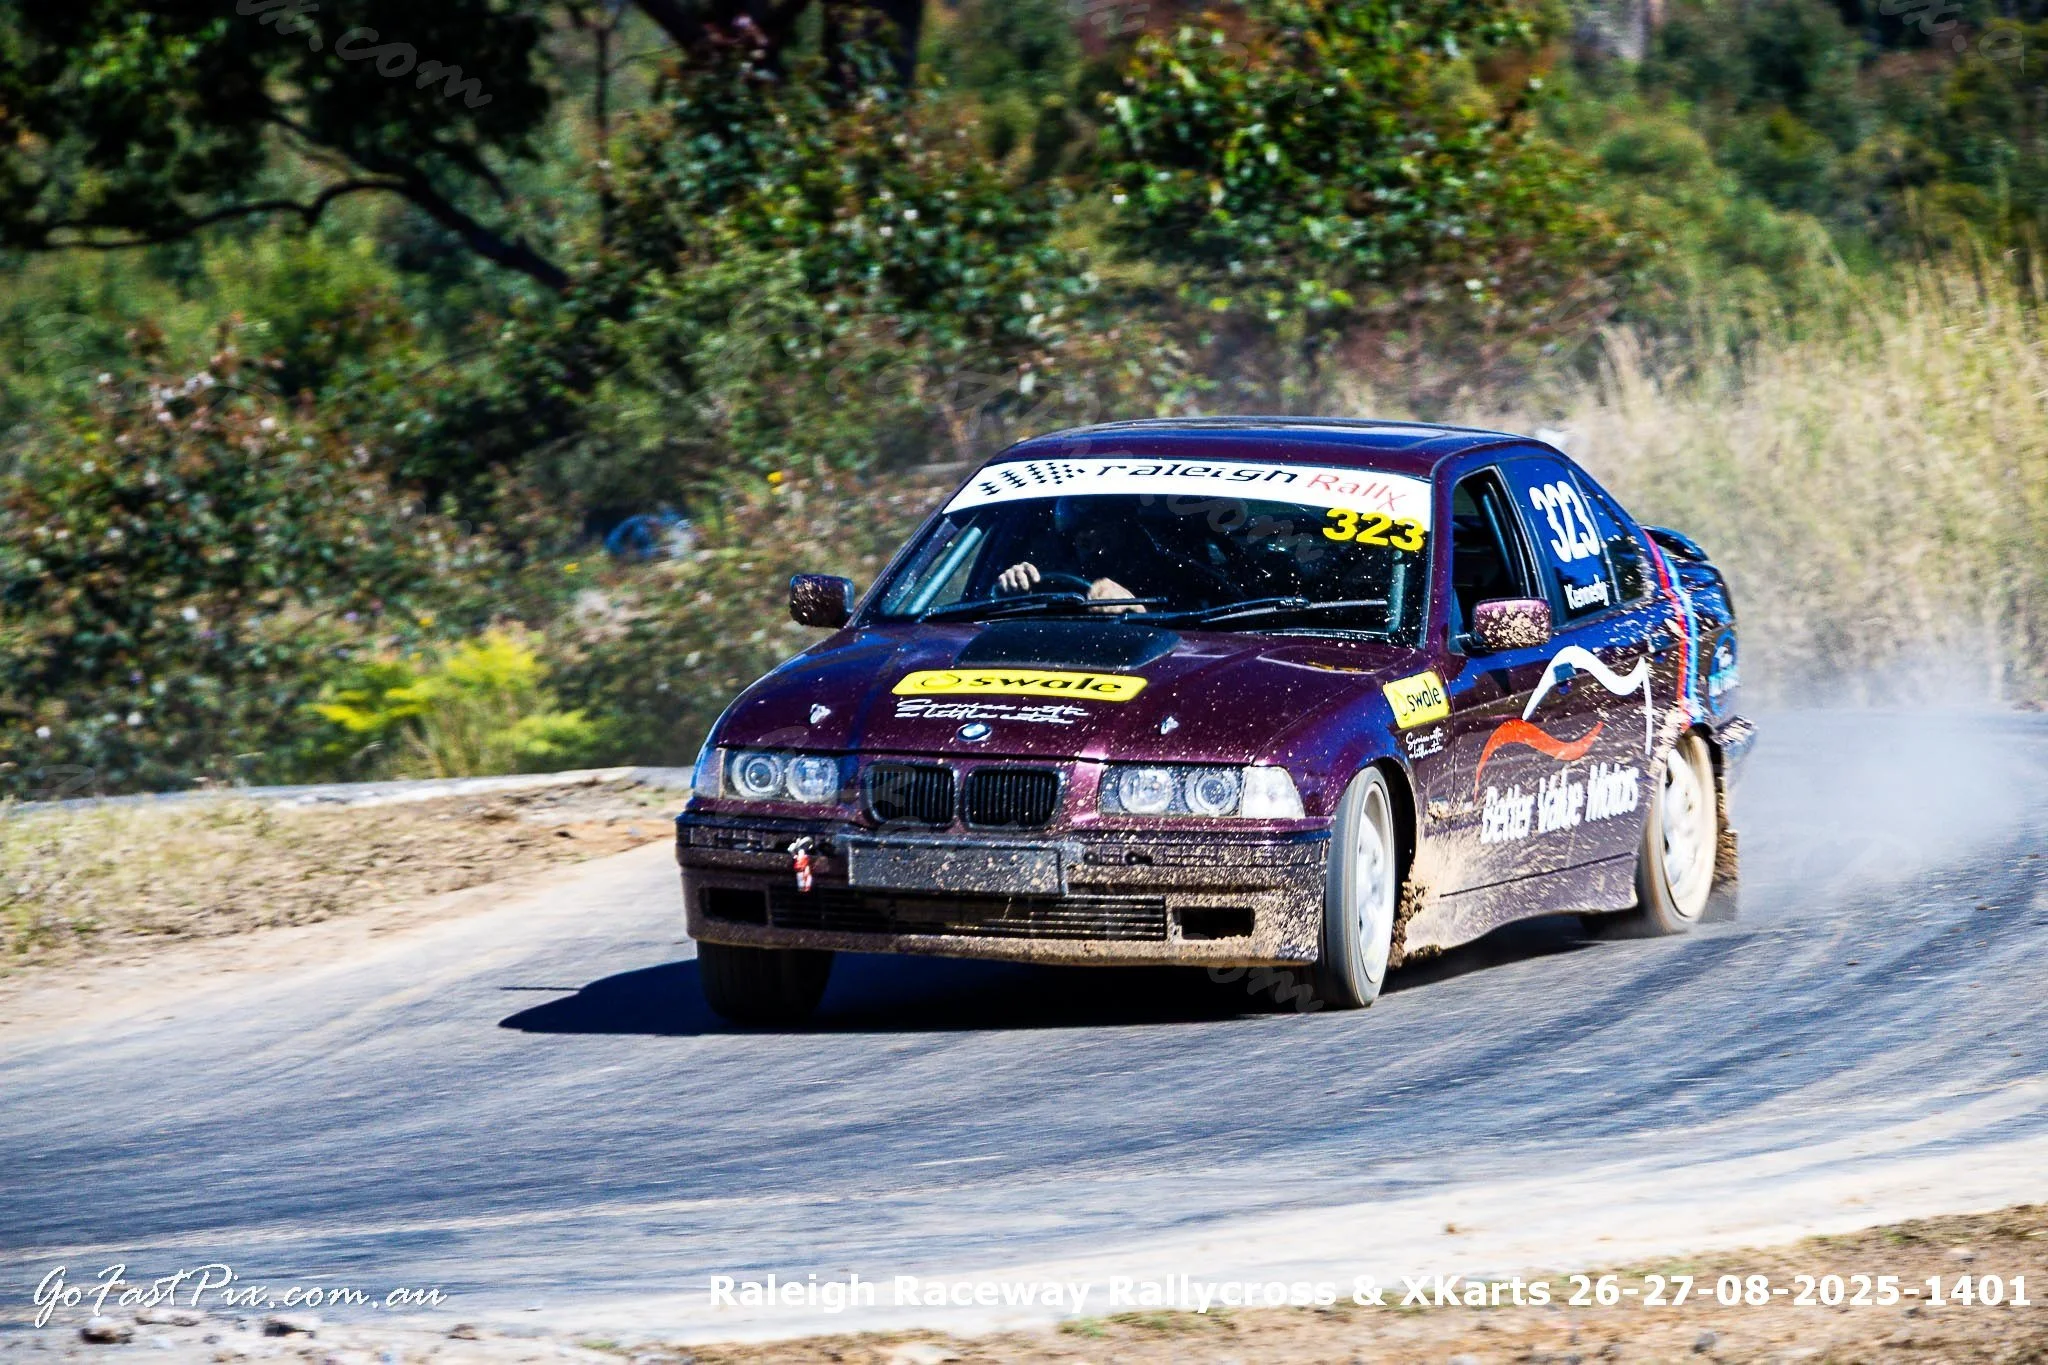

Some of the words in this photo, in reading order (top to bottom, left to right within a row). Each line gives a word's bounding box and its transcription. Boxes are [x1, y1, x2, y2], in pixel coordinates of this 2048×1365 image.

[1097, 463, 1298, 483] raleigh
[1322, 507, 1424, 551] 323
[1529, 480, 1600, 562] 323
[1564, 573, 1610, 609] Kennedy
[968, 676, 1122, 693] swale
[1406, 680, 1442, 712] swale
[1480, 784, 1535, 844] Better
[1538, 767, 1584, 834] Value
